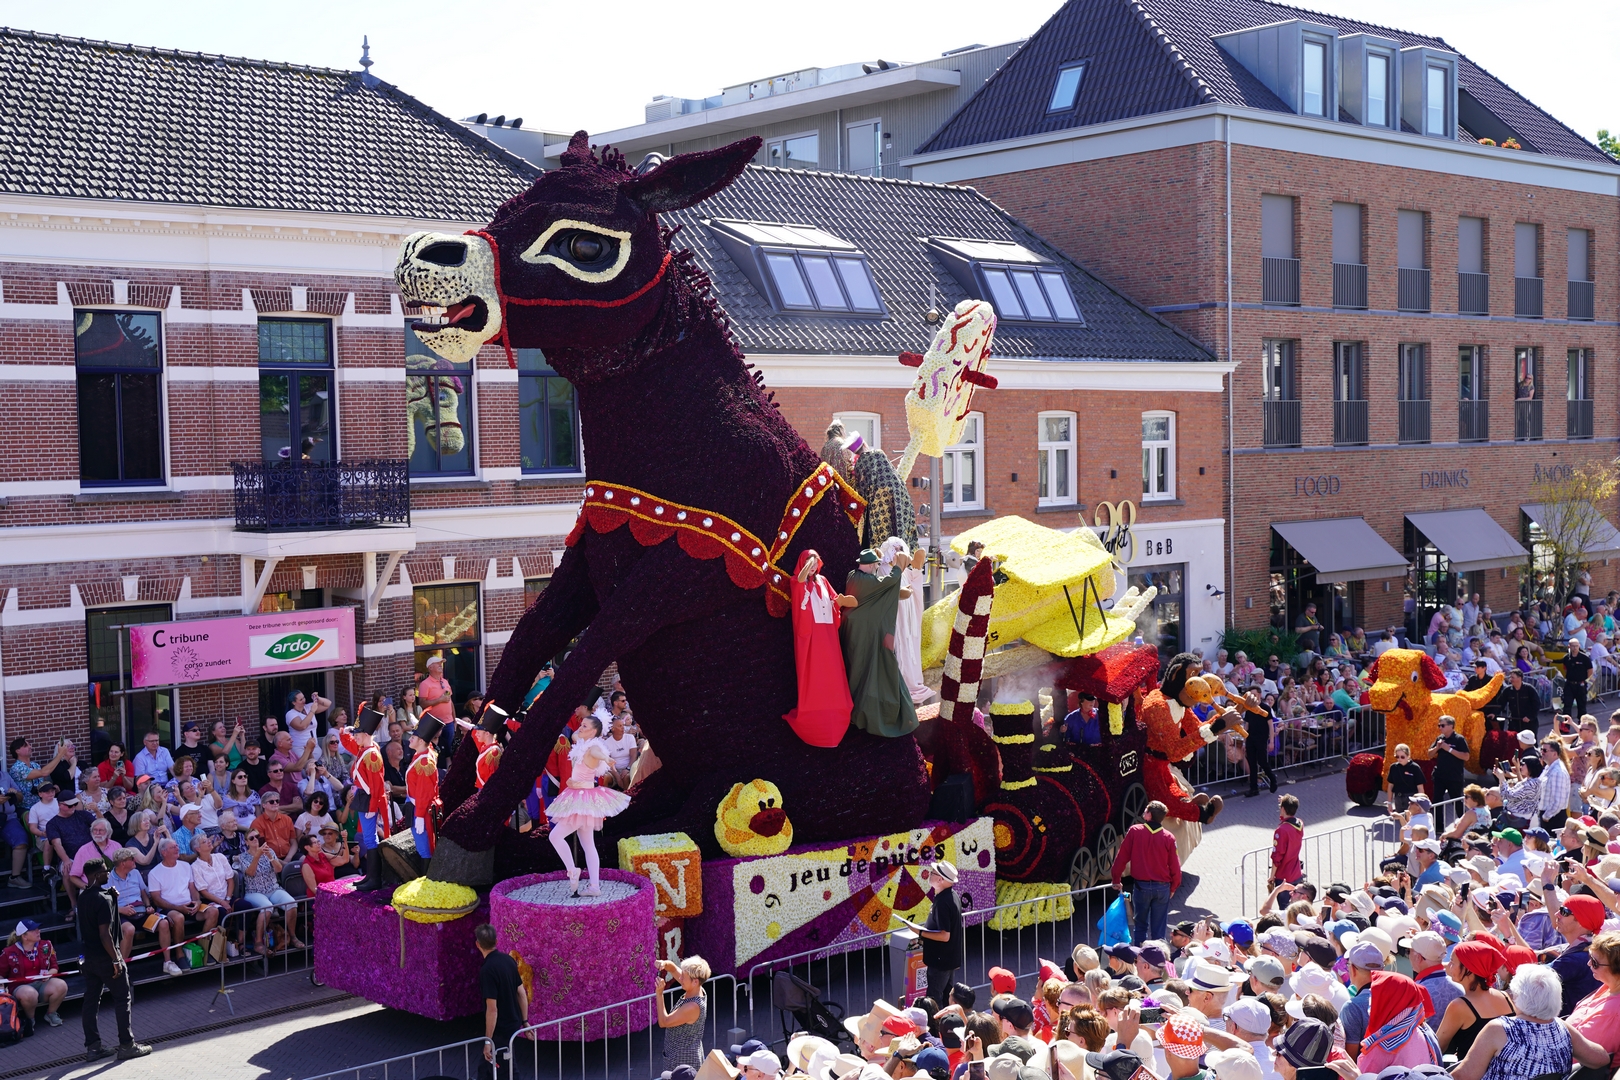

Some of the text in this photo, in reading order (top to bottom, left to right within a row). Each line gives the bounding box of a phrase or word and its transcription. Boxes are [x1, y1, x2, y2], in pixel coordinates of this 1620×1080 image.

[1295, 475, 1340, 496] FOOD
[1421, 469, 1469, 489] DRINKS
[152, 629, 209, 648] C tribune
[272, 638, 311, 654] ardo
[205, 658, 232, 667] zundert
[839, 858, 867, 877] de
[875, 843, 945, 875] puces
[642, 858, 690, 912] N
[871, 909, 881, 922] 8
